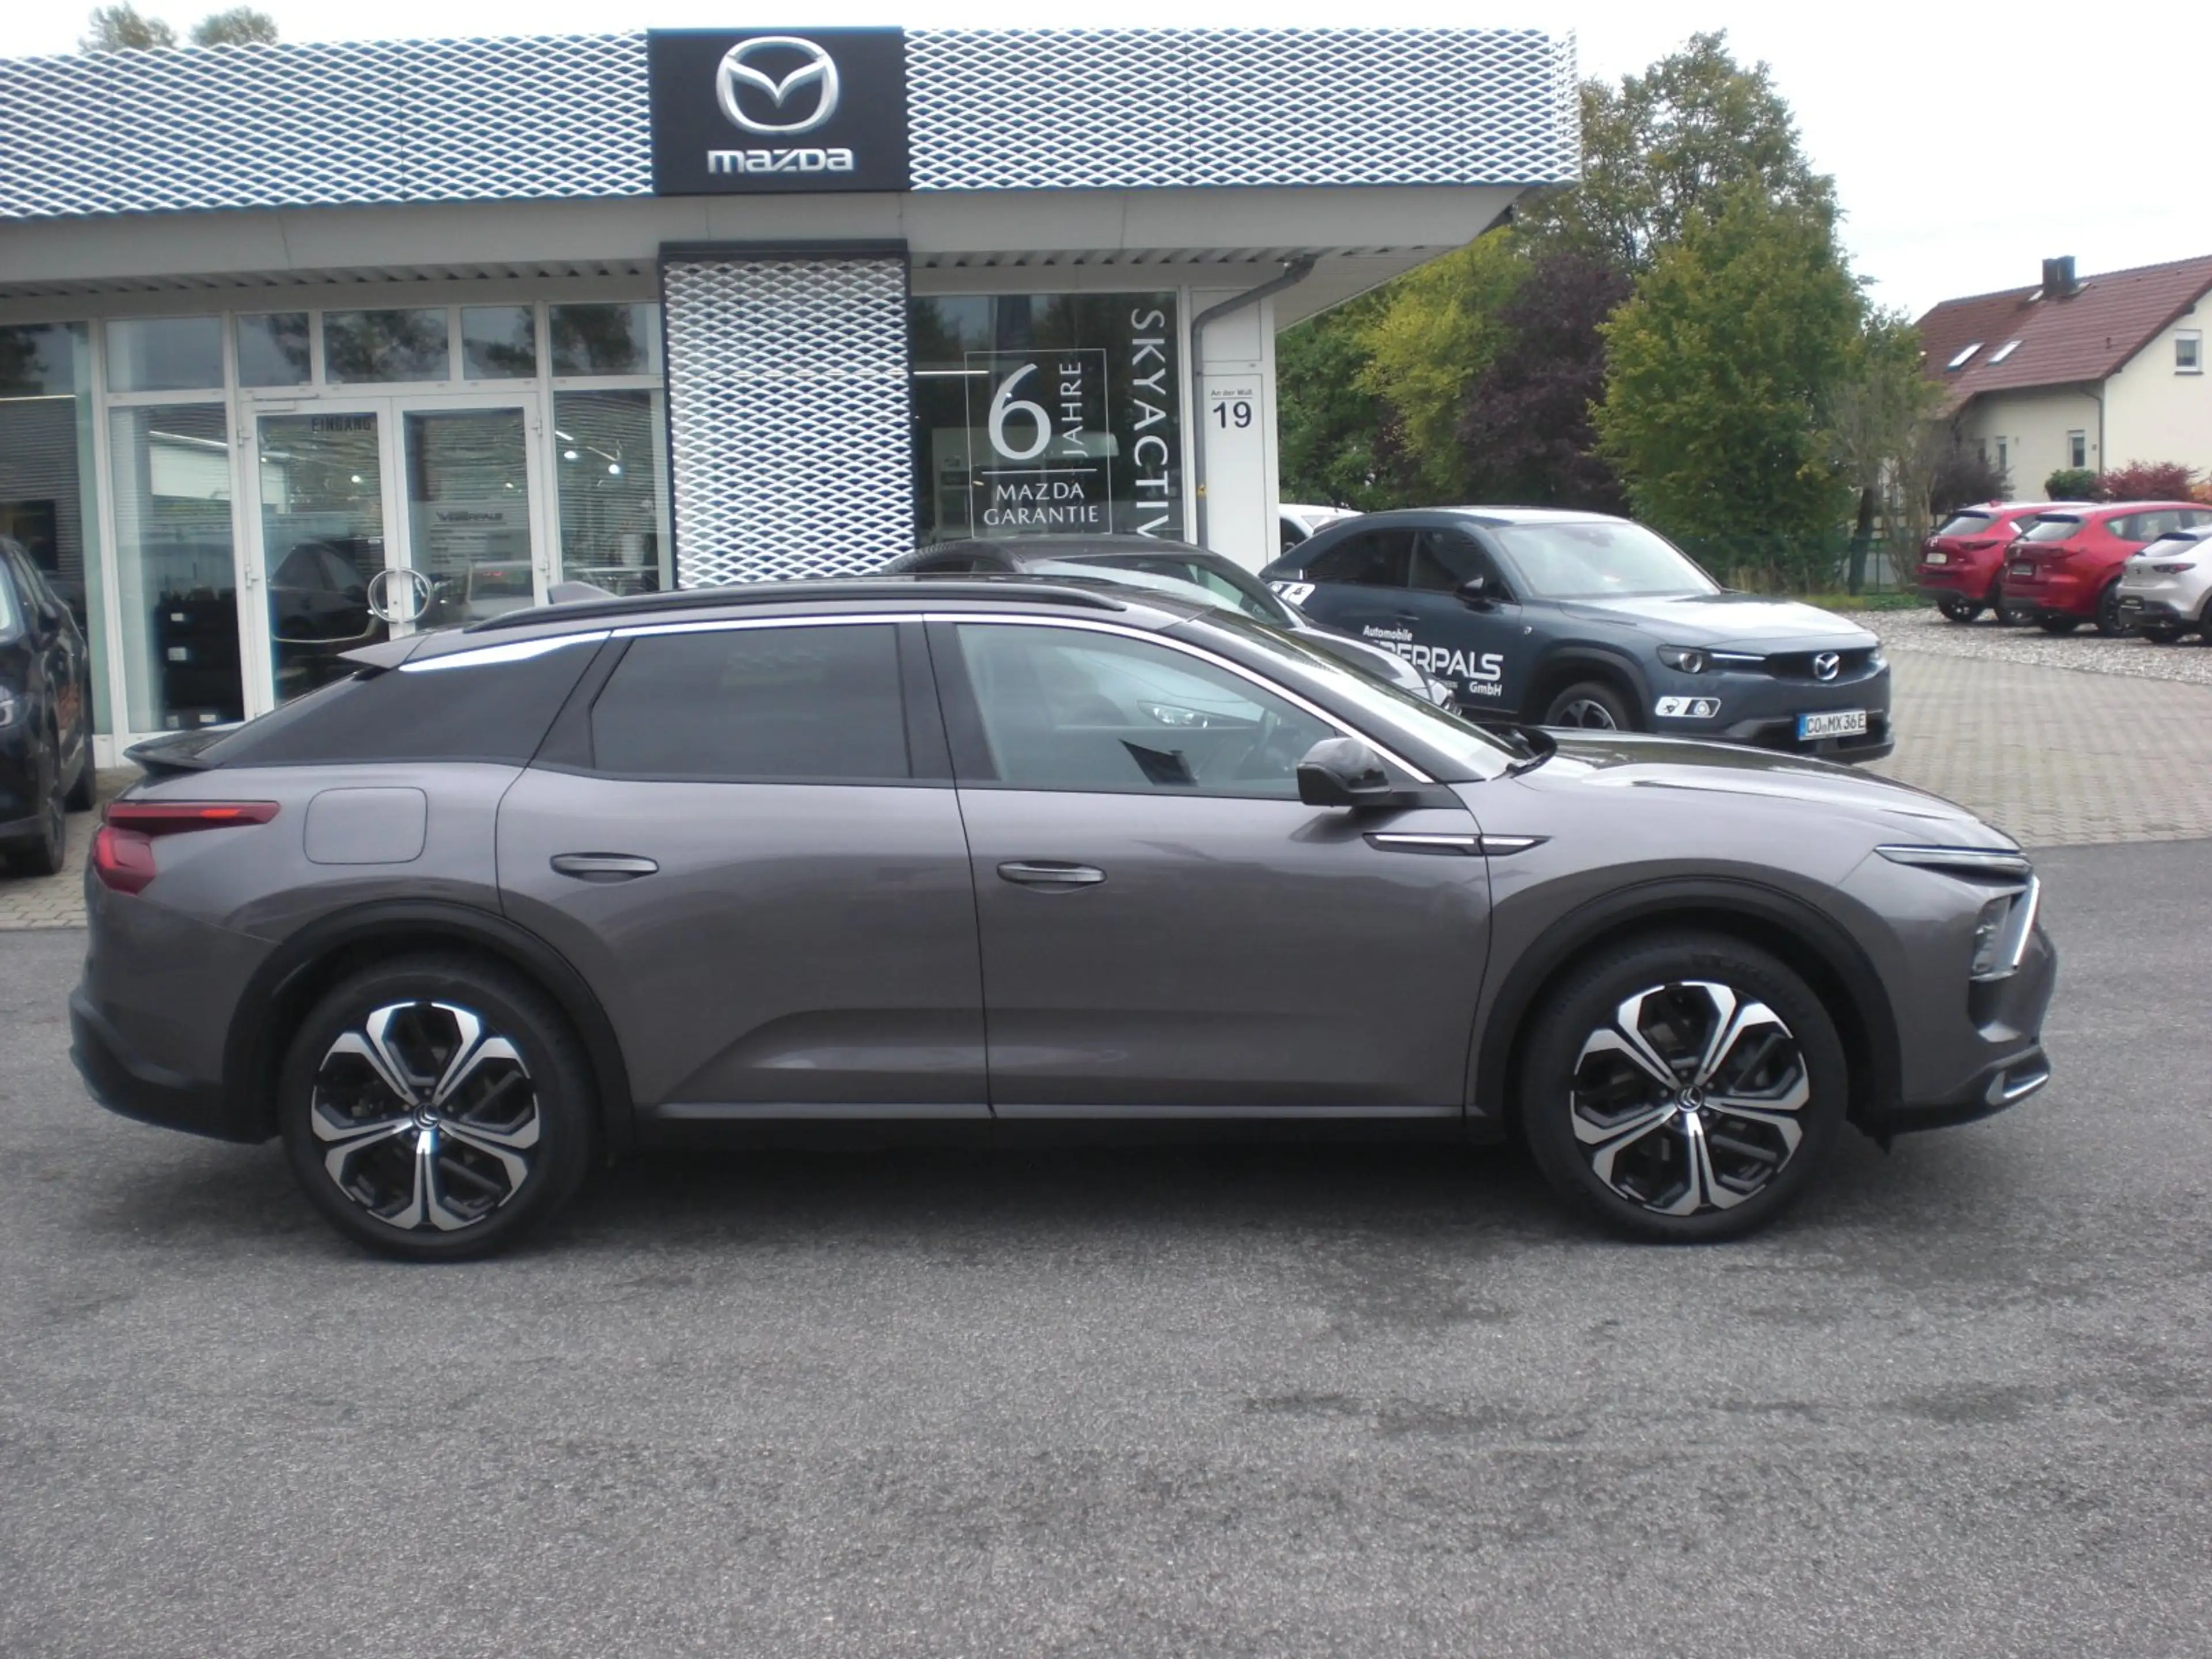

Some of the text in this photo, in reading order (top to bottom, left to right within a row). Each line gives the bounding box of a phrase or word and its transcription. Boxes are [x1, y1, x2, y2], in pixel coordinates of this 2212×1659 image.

[988, 363, 1052, 460] 6
[1059, 362, 1089, 457] JAHRE
[1213, 401, 1252, 429] 19
[312, 416, 372, 432] EINGANG
[1131, 308, 1169, 539] SKYACTIV
[996, 483, 1085, 501] MAZDA
[984, 506, 1099, 525] GARANTIE
[1363, 625, 1412, 641] Automobile
[1469, 681, 1502, 696] GmbH
